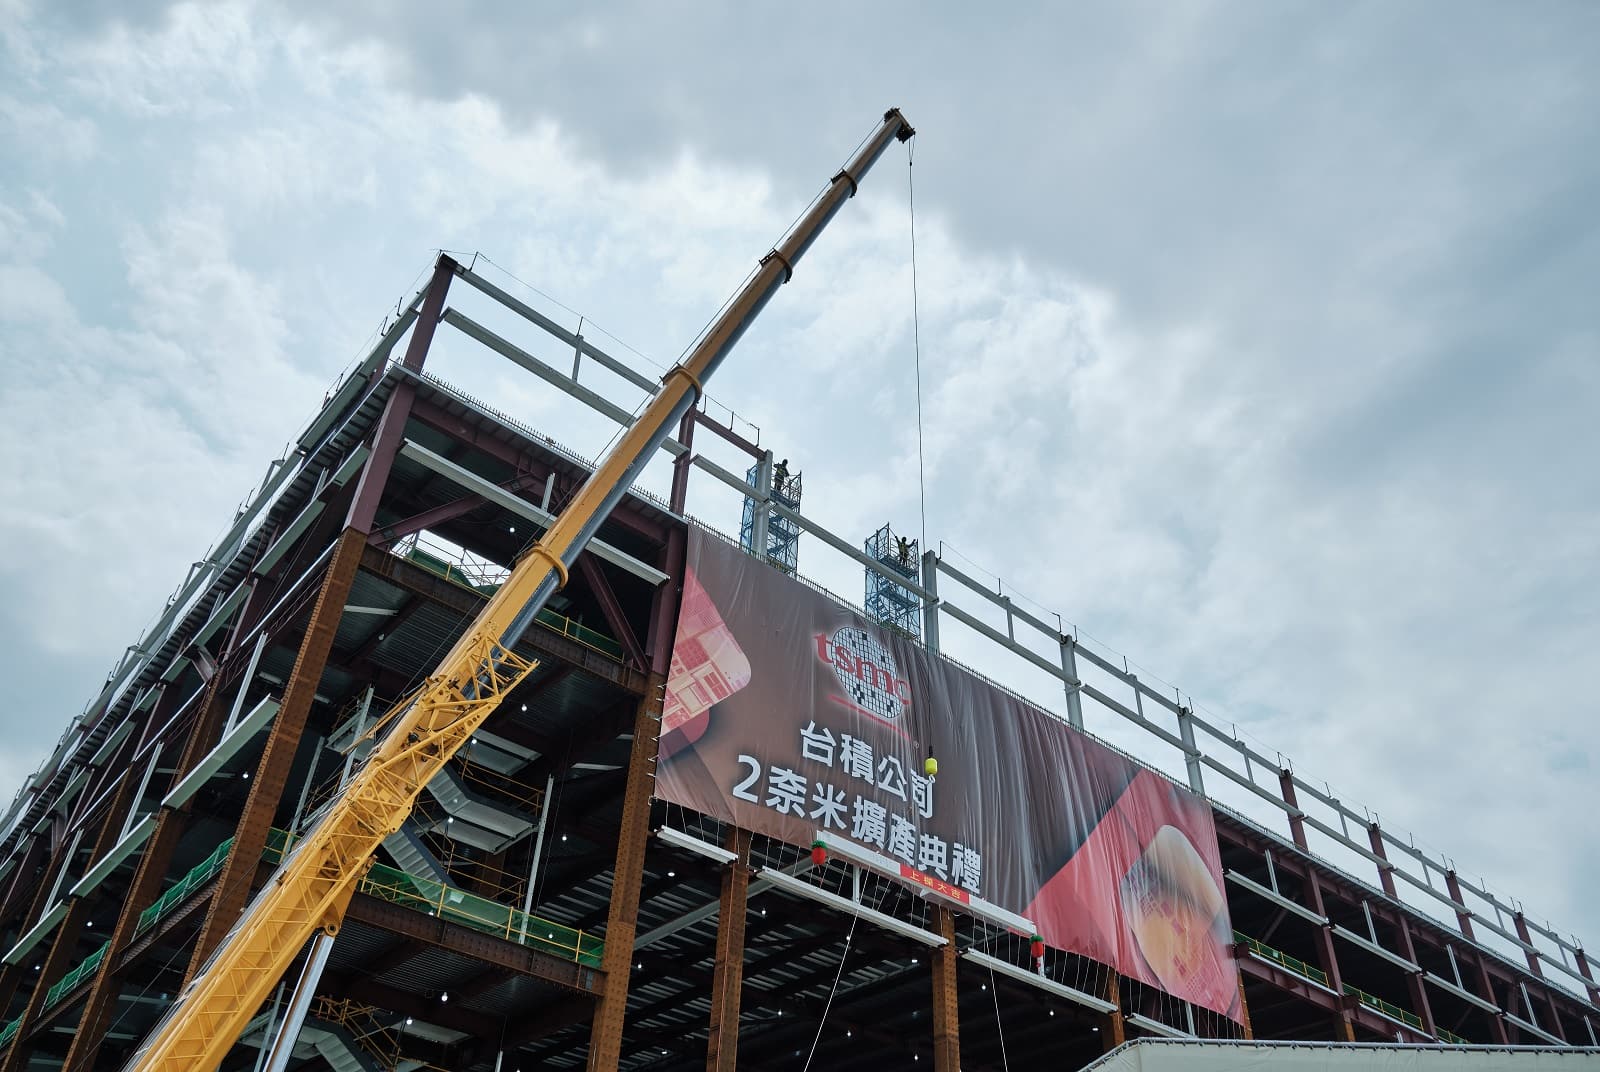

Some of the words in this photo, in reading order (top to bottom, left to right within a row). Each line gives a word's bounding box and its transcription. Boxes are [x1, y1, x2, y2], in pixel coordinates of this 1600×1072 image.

[814, 632, 913, 705] tsmc
[800, 719, 933, 819] 台積公司
[732, 754, 981, 894] 2奈米擴產典禮
